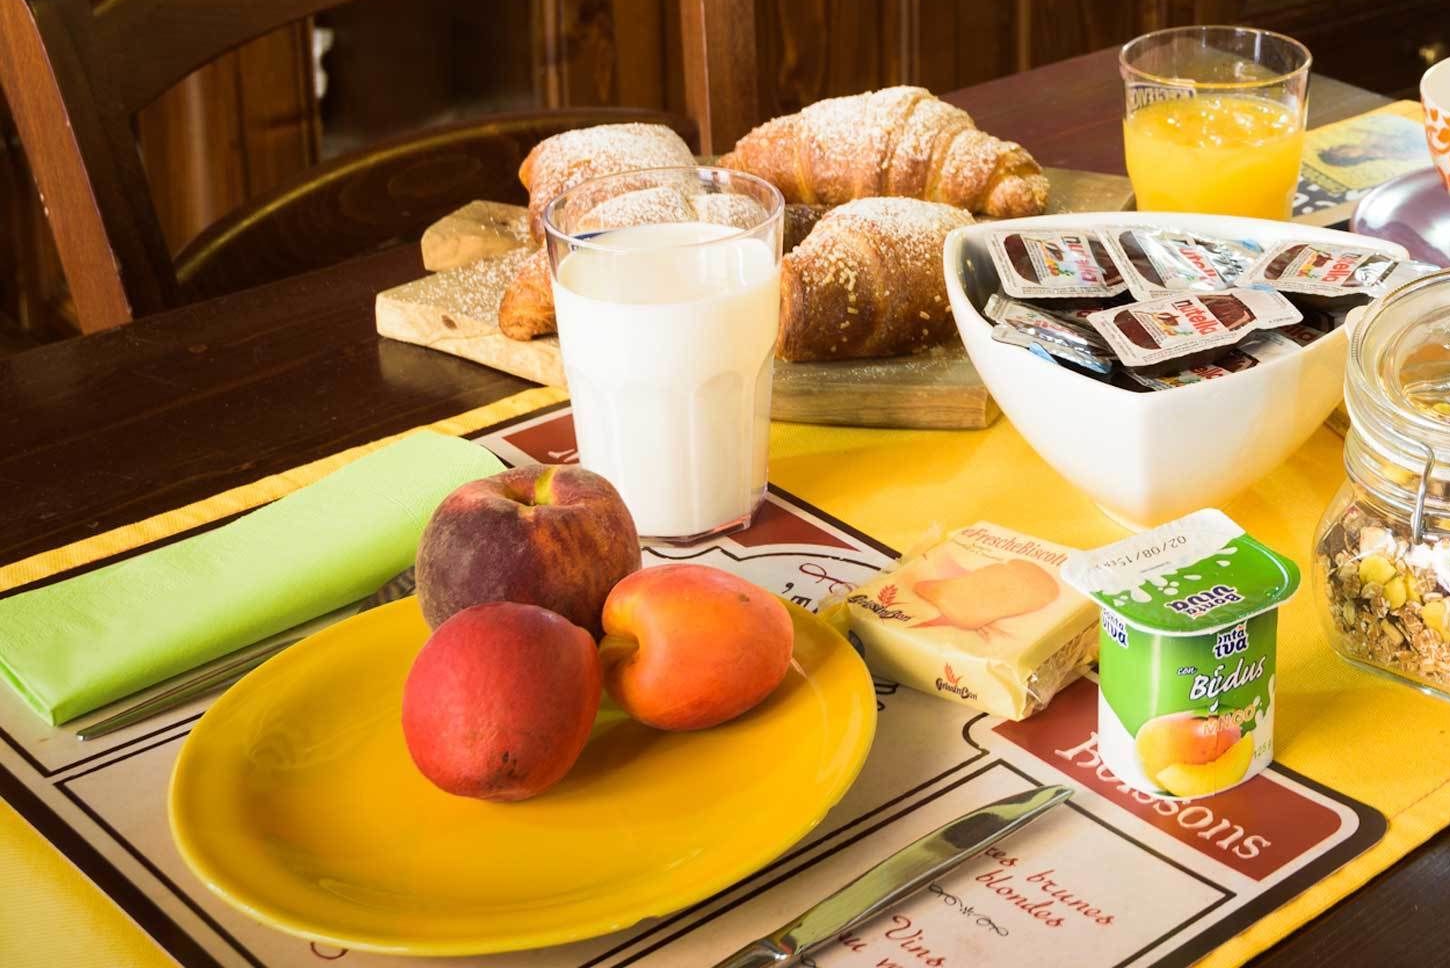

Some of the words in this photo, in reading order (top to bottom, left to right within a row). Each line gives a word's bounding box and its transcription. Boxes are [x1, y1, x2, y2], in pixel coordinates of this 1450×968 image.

[1174, 298, 1218, 336] nutella
[1167, 584, 1235, 612] viva
[975, 869, 1066, 928] blondes
